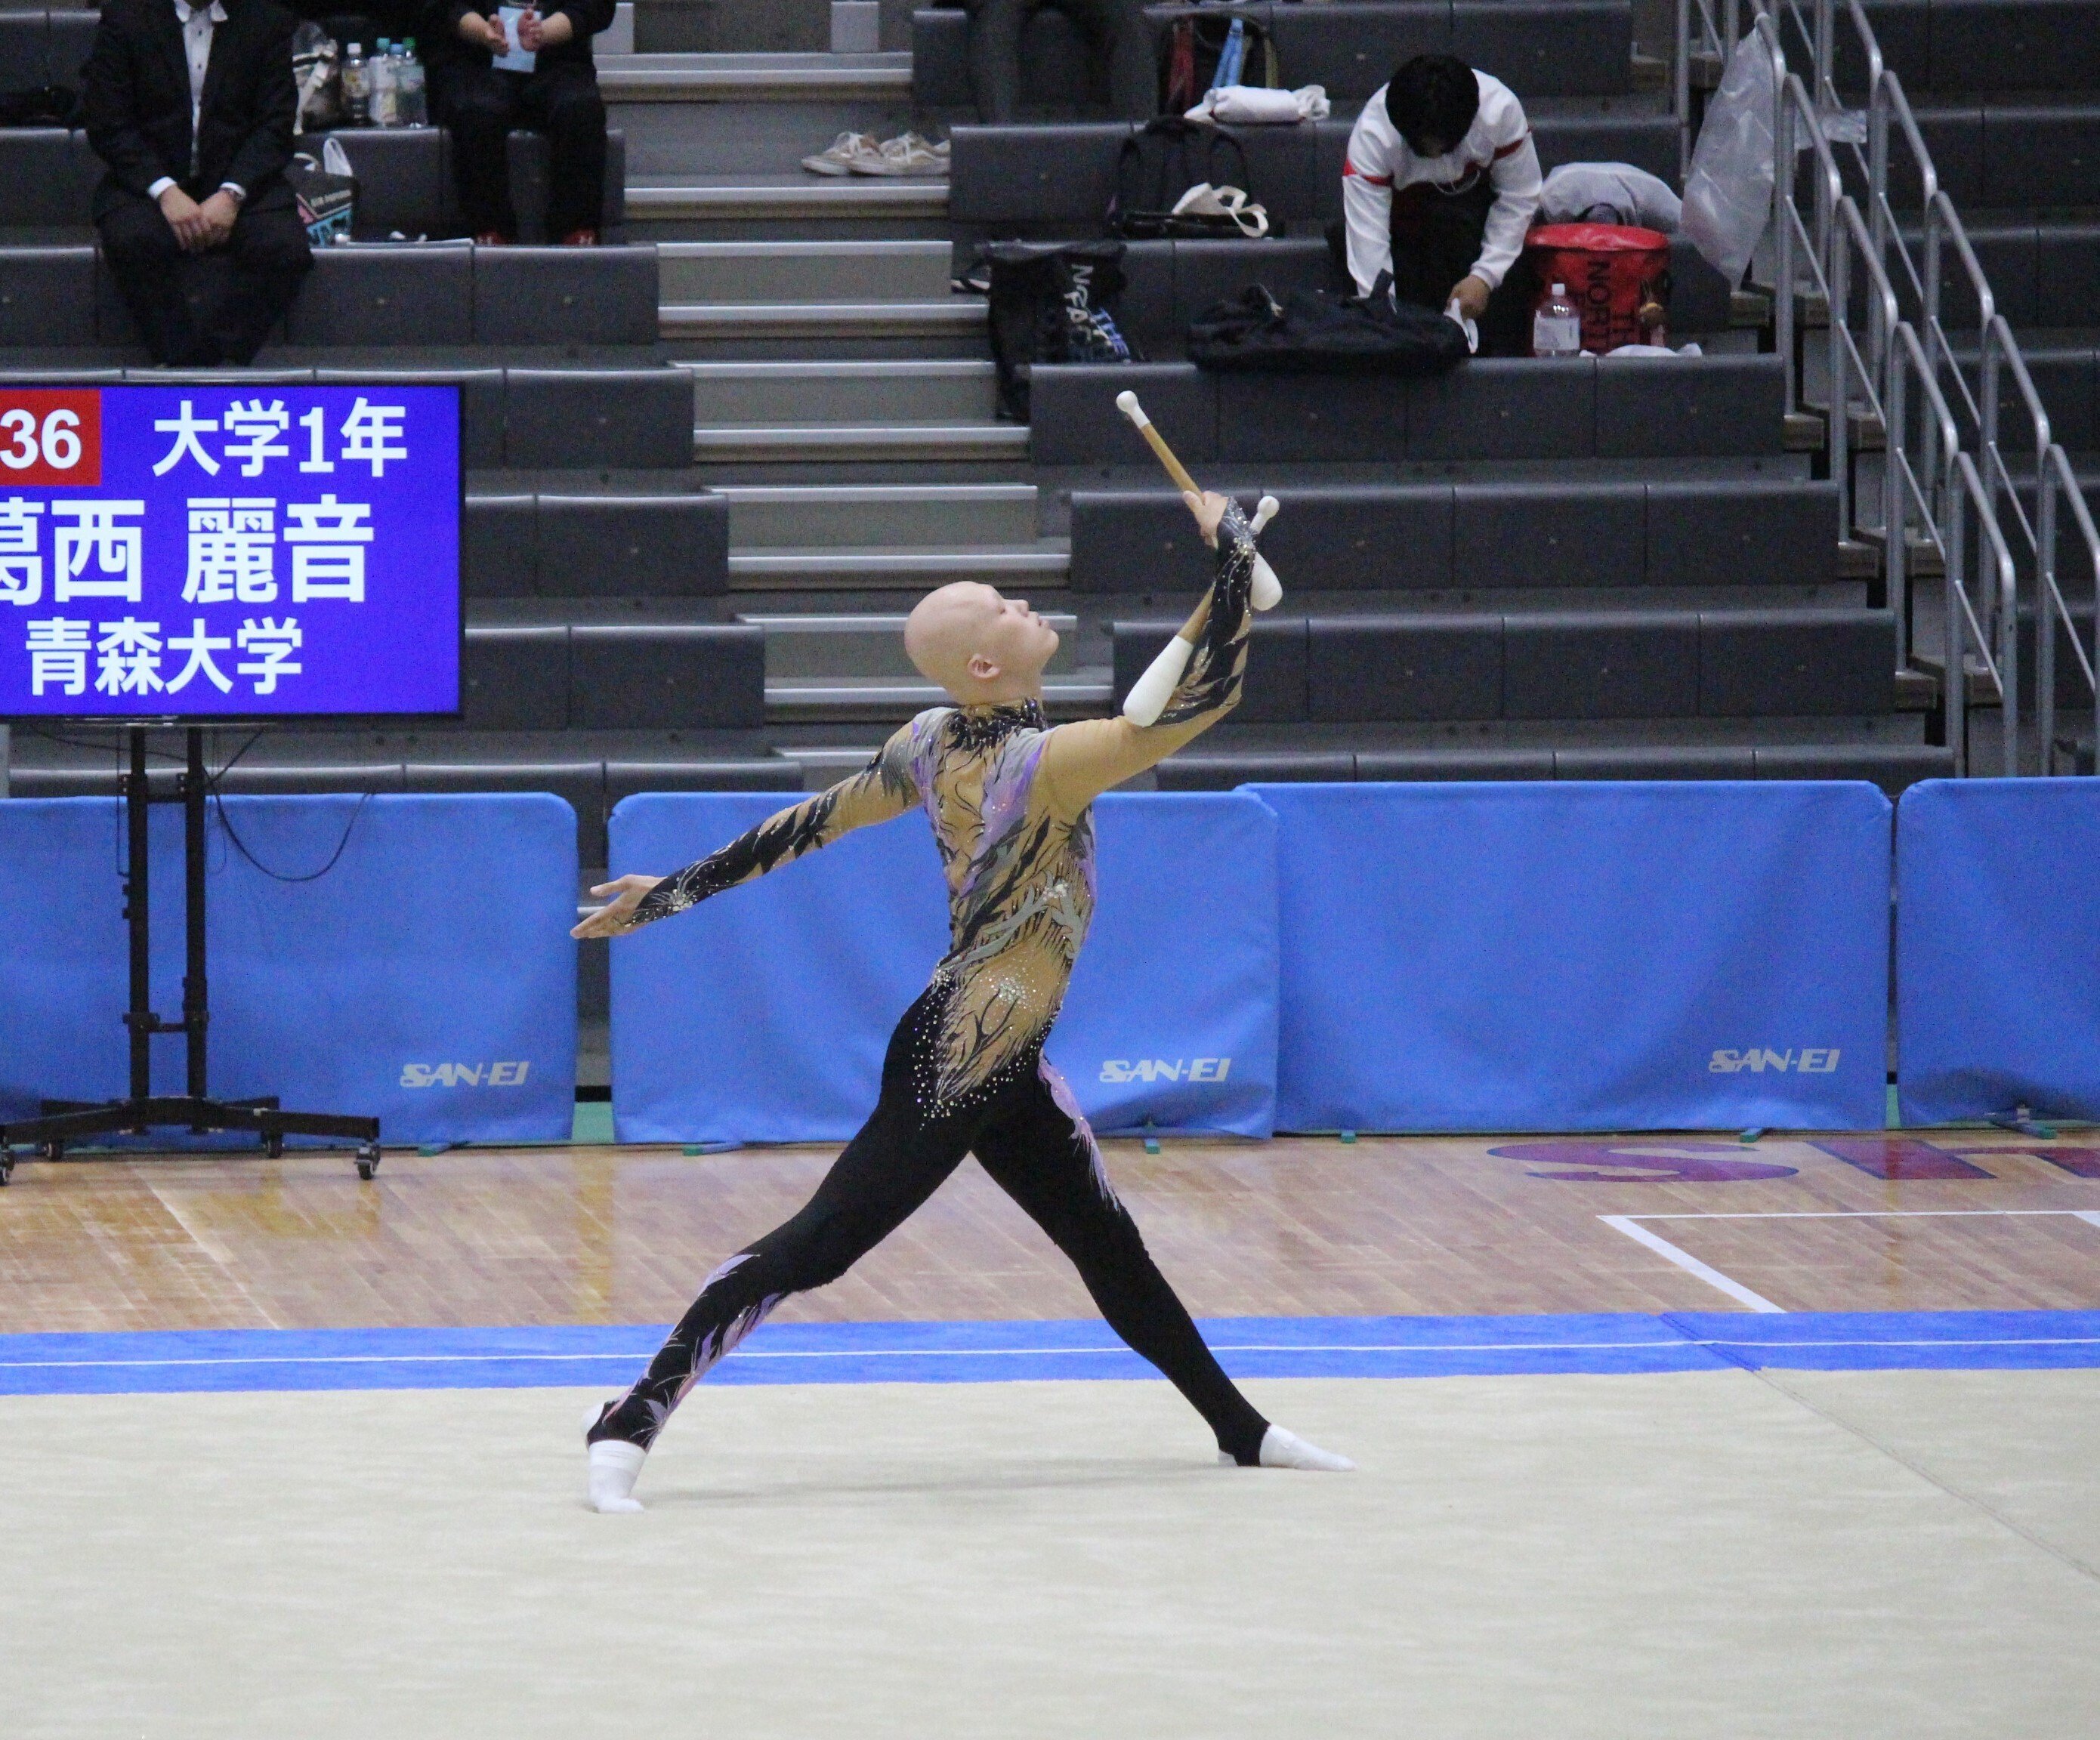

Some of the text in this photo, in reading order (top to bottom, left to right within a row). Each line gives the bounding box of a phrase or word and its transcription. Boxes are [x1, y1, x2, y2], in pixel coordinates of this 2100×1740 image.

[0, 409, 82, 469] 36
[152, 397, 407, 477] 大学1年
[181, 494, 374, 603] 麗音
[26, 617, 302, 696] 青森大学
[400, 1061, 530, 1088] SAN-EI
[1099, 1058, 1232, 1083] SAN-EI
[1708, 1048, 1841, 1073] SAN-EI
